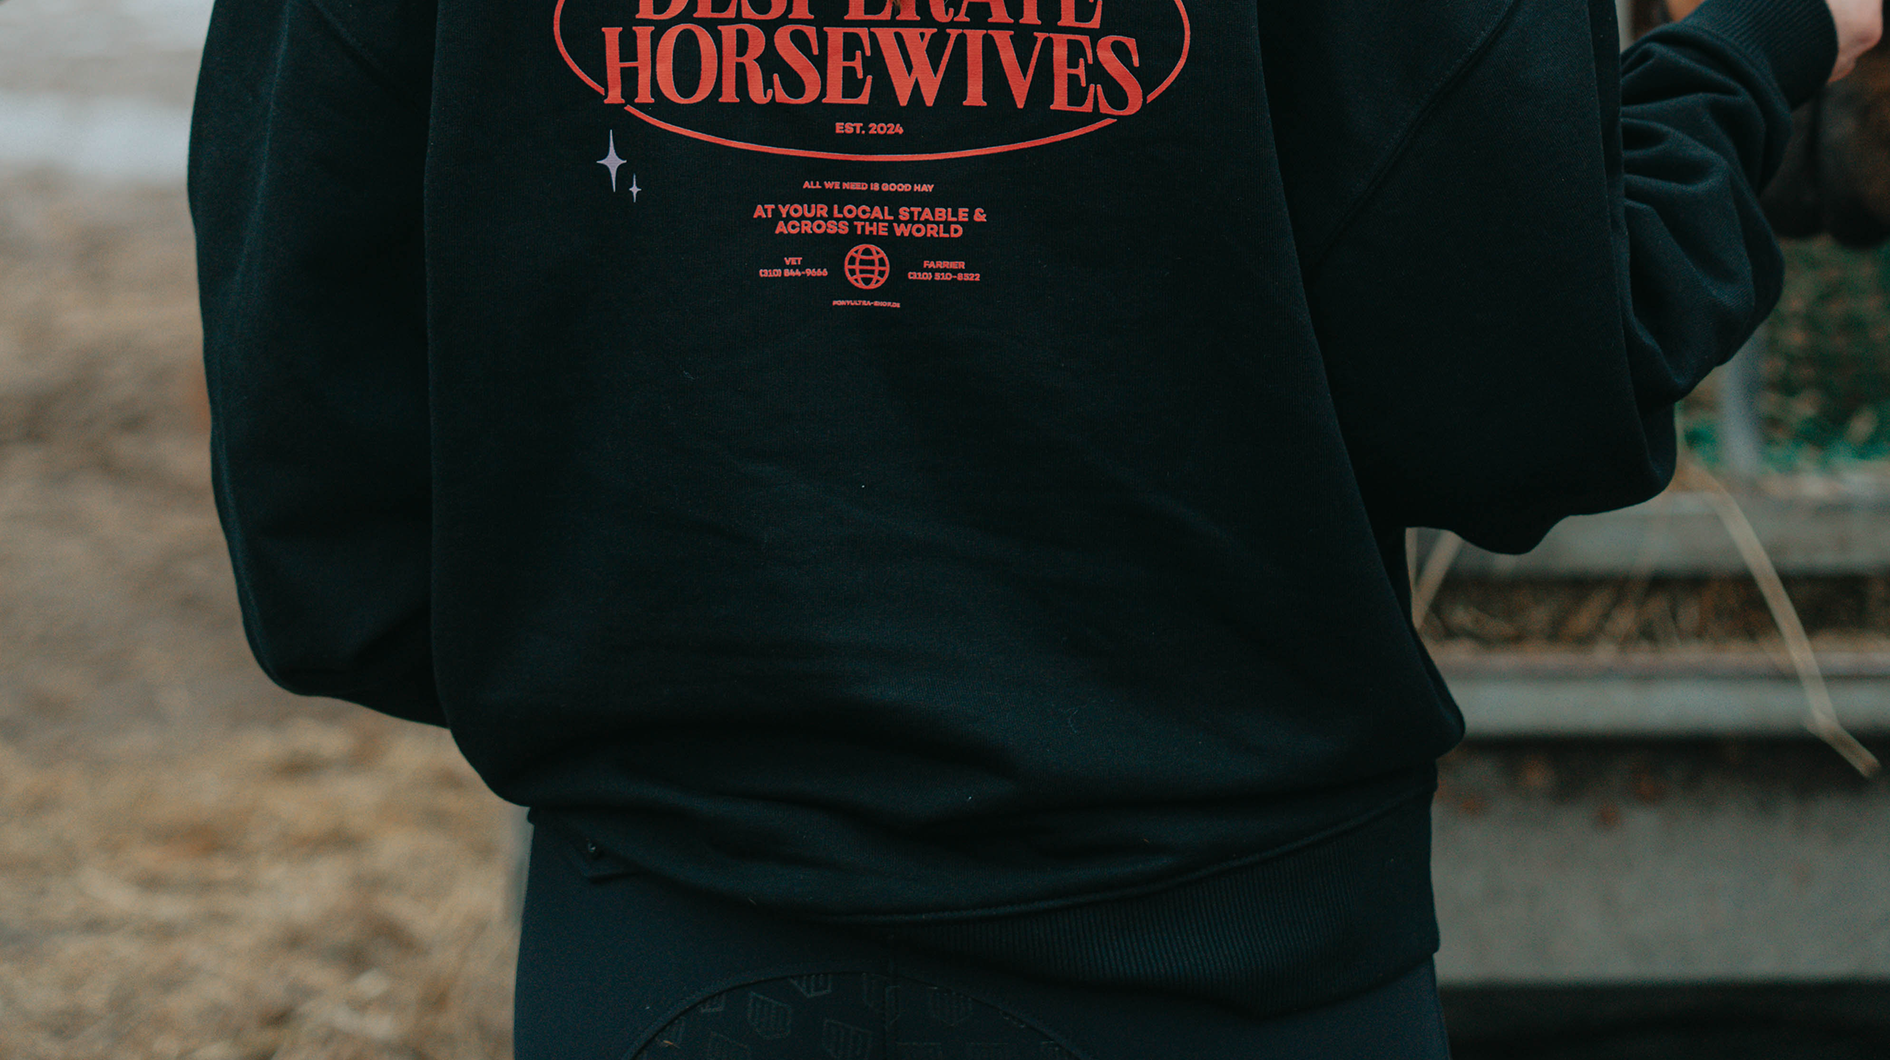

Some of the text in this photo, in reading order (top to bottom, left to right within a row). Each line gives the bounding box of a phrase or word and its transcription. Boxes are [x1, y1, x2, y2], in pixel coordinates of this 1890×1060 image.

[601, 23, 1144, 116] HORSEWIVES
[835, 122, 904, 135] EST. 2024
[802, 181, 935, 193] ALL WE NEED IS GOOD HAY
[753, 204, 987, 223] AT YOUR LOCAL STABLE &
[775, 220, 964, 239] ACROSS THE WORLD
[783, 257, 803, 266] VET
[923, 260, 966, 270] FARRIER
